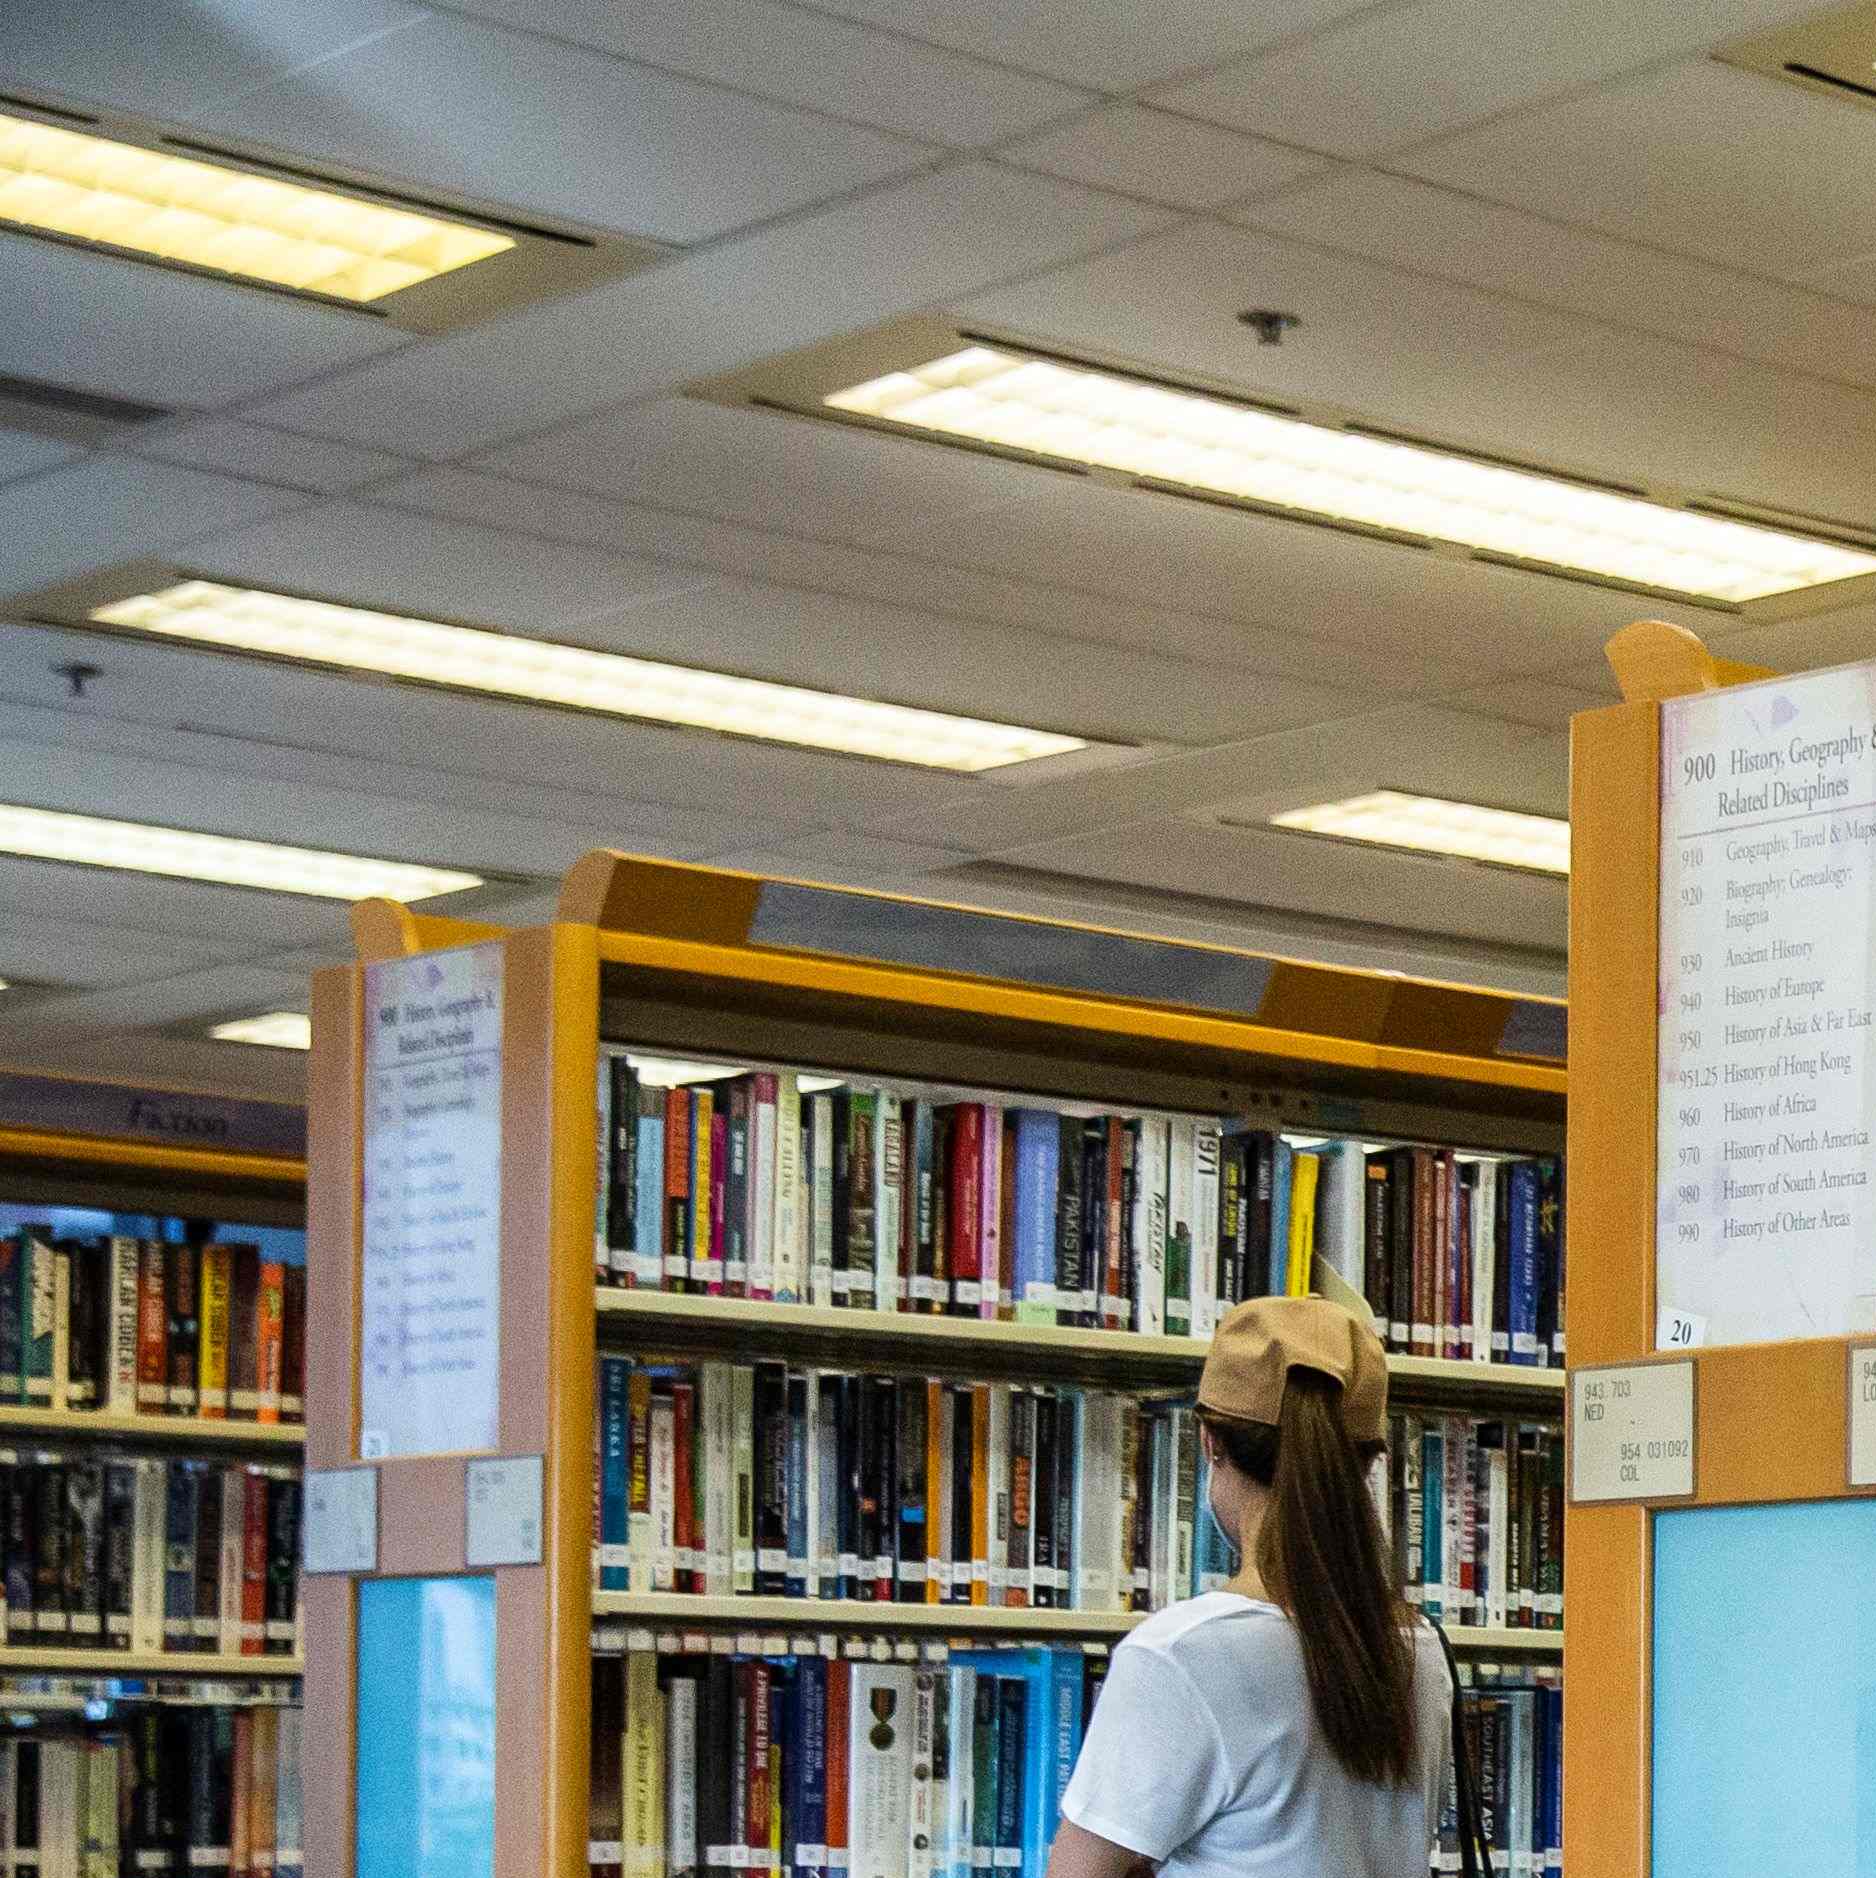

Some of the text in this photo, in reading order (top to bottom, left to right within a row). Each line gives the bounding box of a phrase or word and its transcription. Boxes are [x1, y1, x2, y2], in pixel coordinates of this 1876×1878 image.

[1684, 752, 1716, 787] 900
[1730, 745, 1785, 777] History,
[1788, 725, 1867, 768] Geography
[1718, 774, 1850, 818] Related Disciplines
[1680, 938, 1814, 975] 930 Ancient History
[1680, 975, 1825, 1013] 940 History of Europe
[1680, 1006, 1873, 1051] 950 History of Asia & Far East
[1679, 1049, 1851, 1089] 951.25 History of Hong Kong
[129, 1098, 228, 1134] Fiction
[1679, 1092, 1818, 1128] 960 History of Africa
[1679, 1127, 1871, 1167] 970 History of North America
[1678, 1168, 1868, 1205] 980 History of South America
[1062, 1194, 1080, 1291] PAKISTAN
[1678, 1209, 1851, 1243] 990 History of Other Areas
[1670, 1318, 1692, 1345] 20
[1584, 1403, 1604, 1421] NED
[1620, 1464, 1640, 1482] COL
